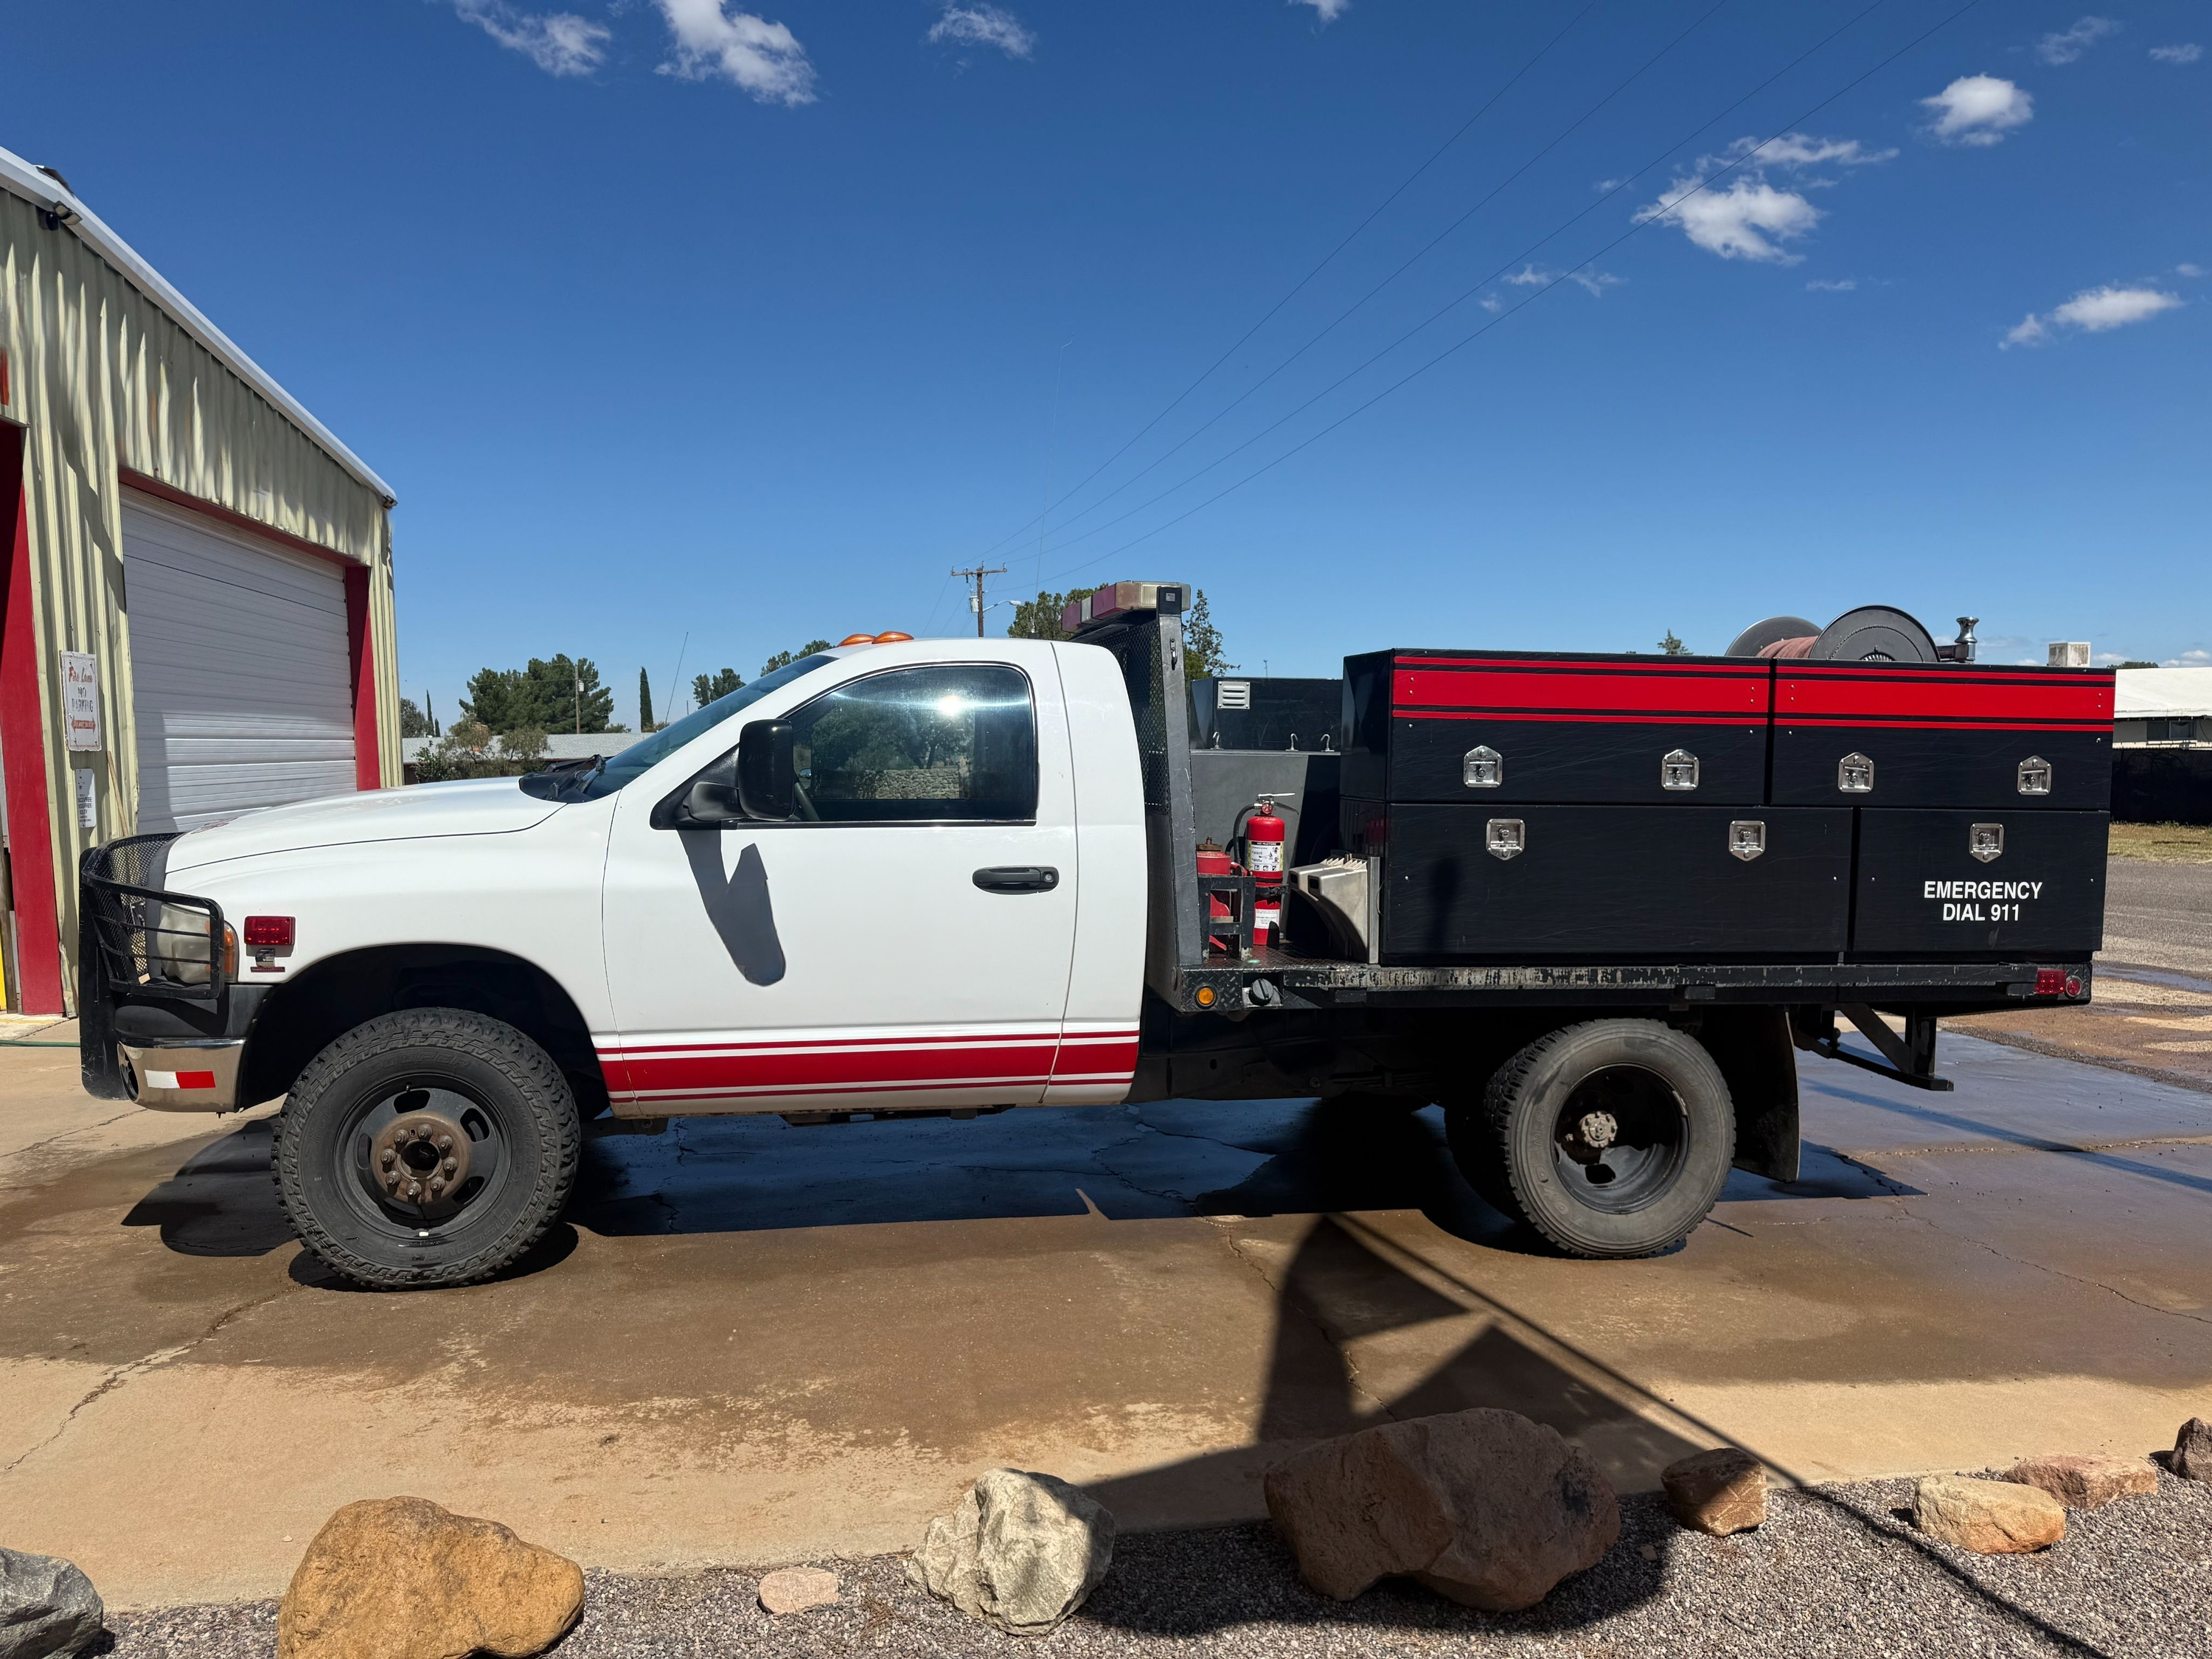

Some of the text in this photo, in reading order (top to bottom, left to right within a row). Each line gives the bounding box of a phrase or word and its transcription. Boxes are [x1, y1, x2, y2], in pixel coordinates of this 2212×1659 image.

[77, 686, 87, 698] NO
[72, 698, 94, 713] PARKING
[1924, 880, 2042, 900] EMERGENCY
[1943, 903, 2020, 921] DIAL 911
[367, 1051, 470, 1077] COOPER
[1535, 1164, 1585, 1230] TOYO
[378, 1209, 512, 1262] DISCOVERER
